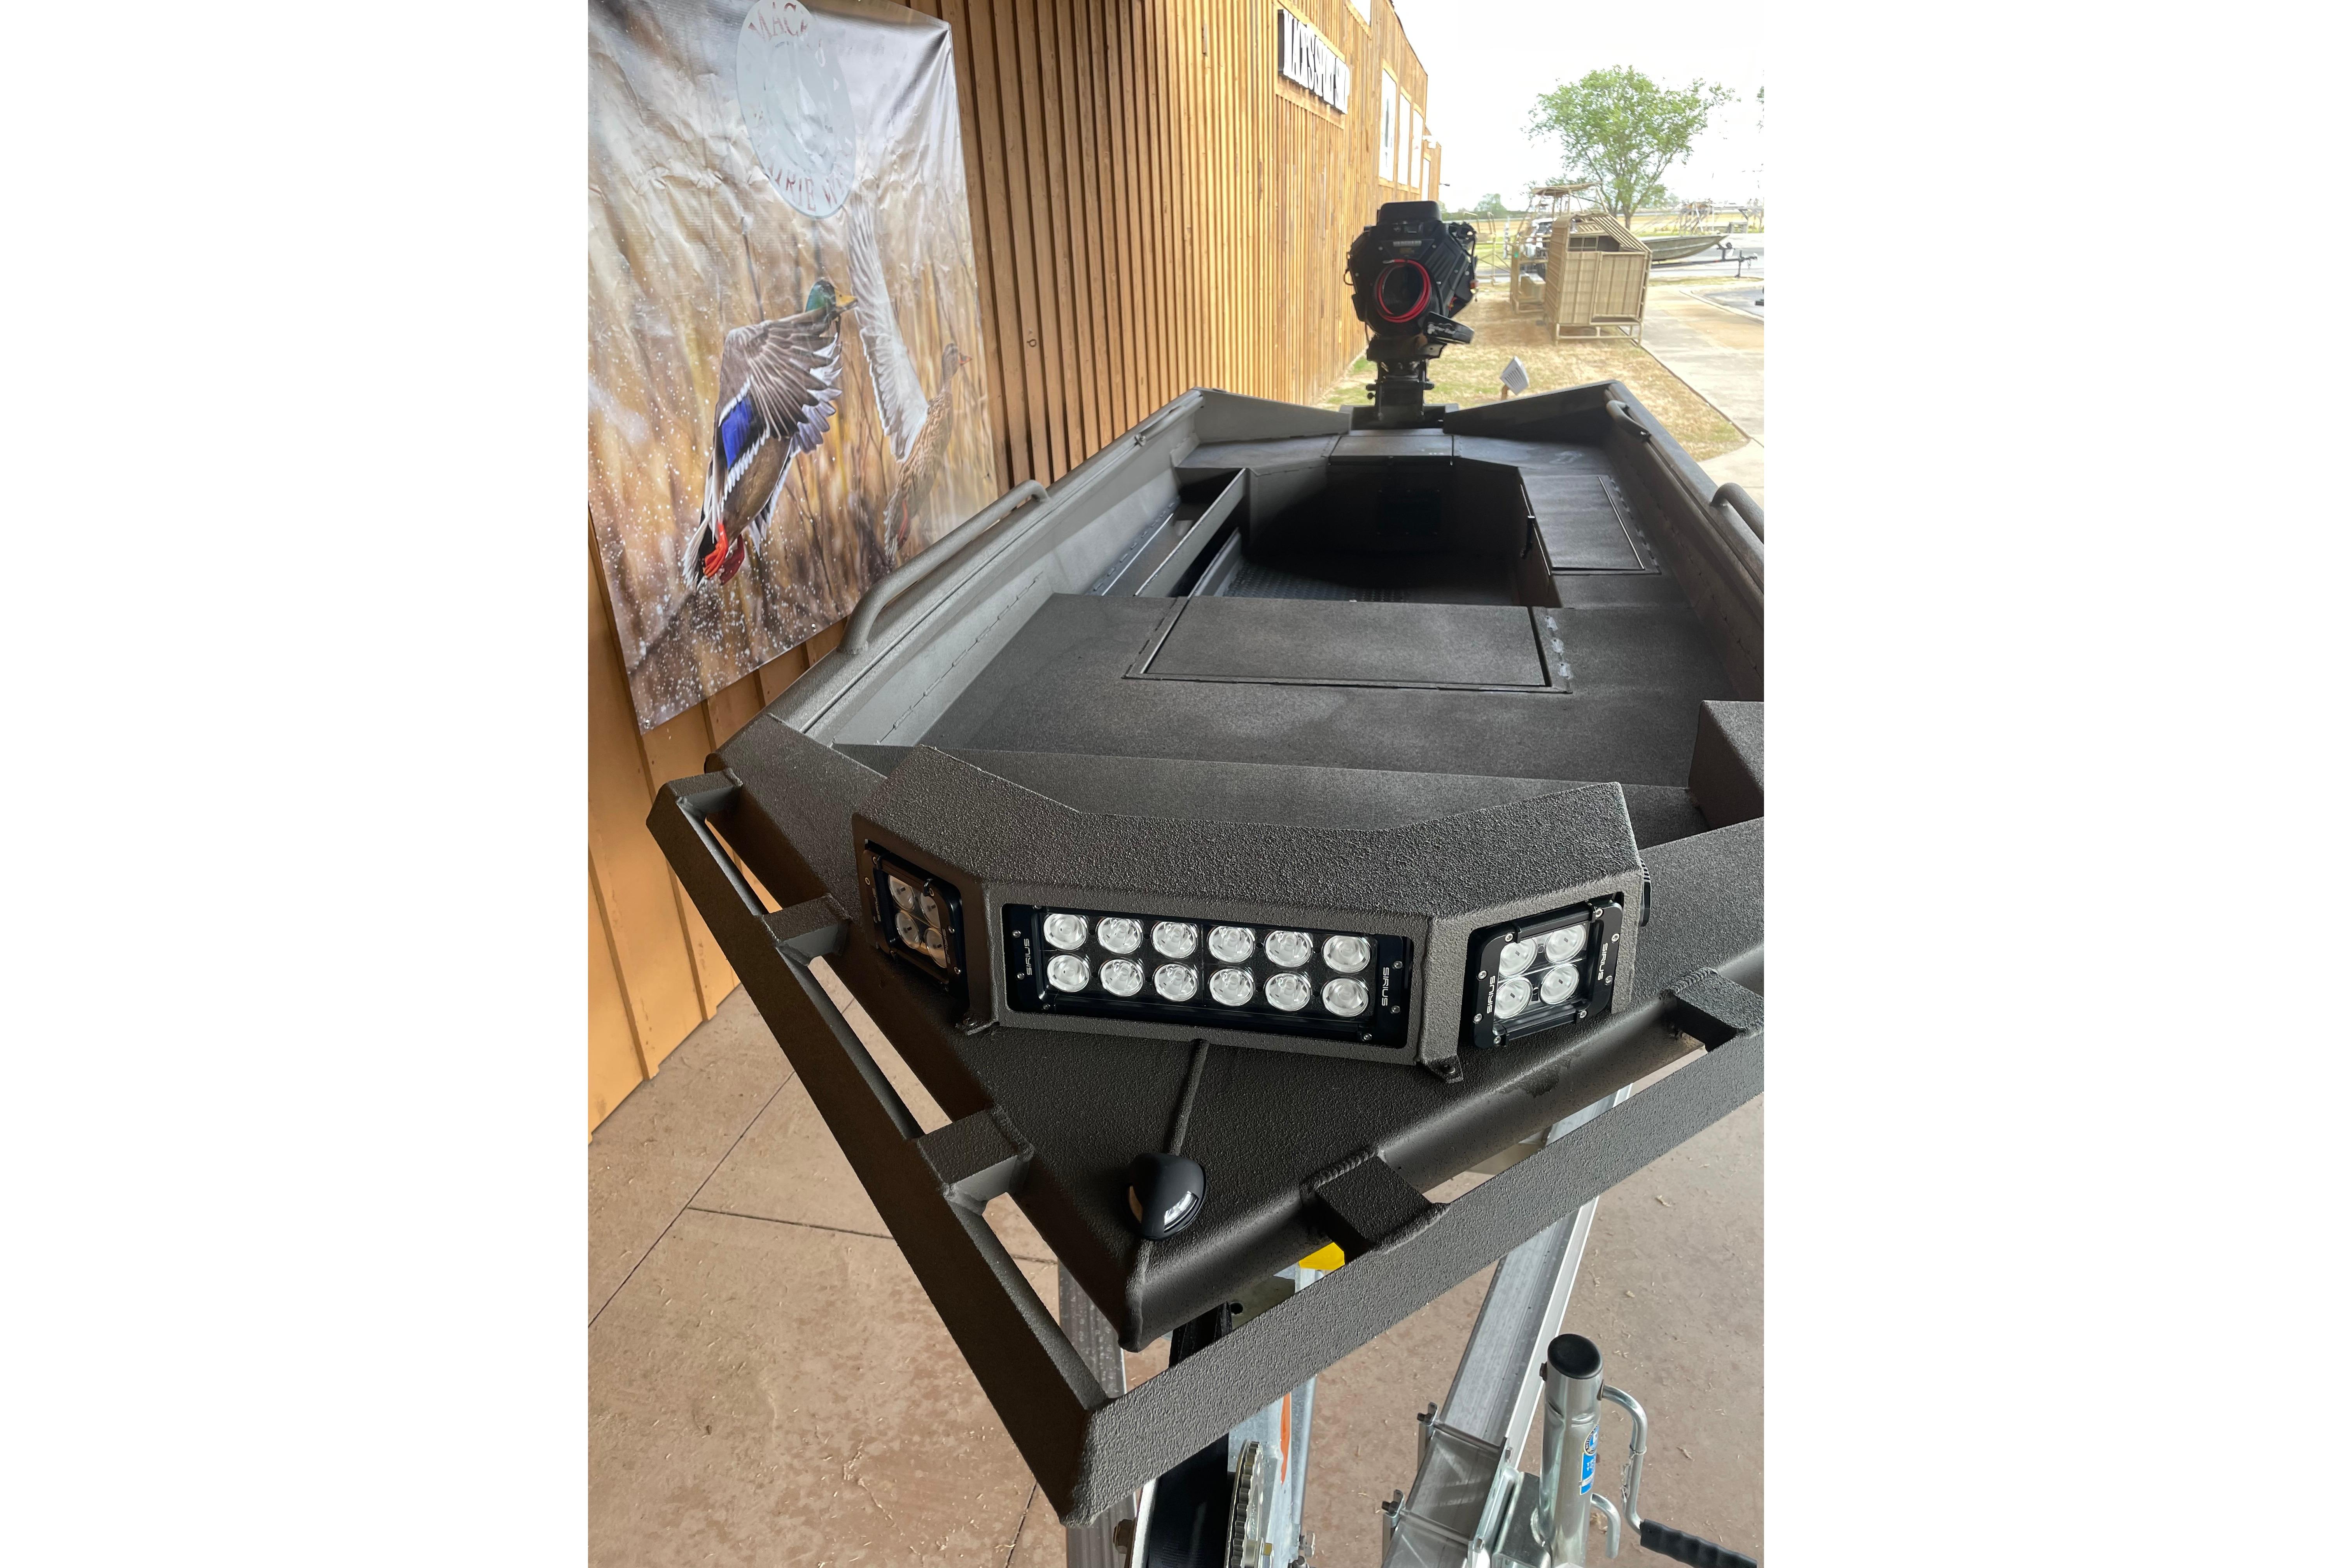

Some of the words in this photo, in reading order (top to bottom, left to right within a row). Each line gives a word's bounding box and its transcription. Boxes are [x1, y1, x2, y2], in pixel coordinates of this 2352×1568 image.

[872, 888, 881, 922] SIRIUS
[942, 928, 950, 965] SIRIUS
[1024, 938, 1032, 975] SIRIUS
[1598, 943, 1608, 980] SIRIUS
[1381, 967, 1390, 1006] SIRIUS
[1487, 975, 1496, 1014] SIRIUS
